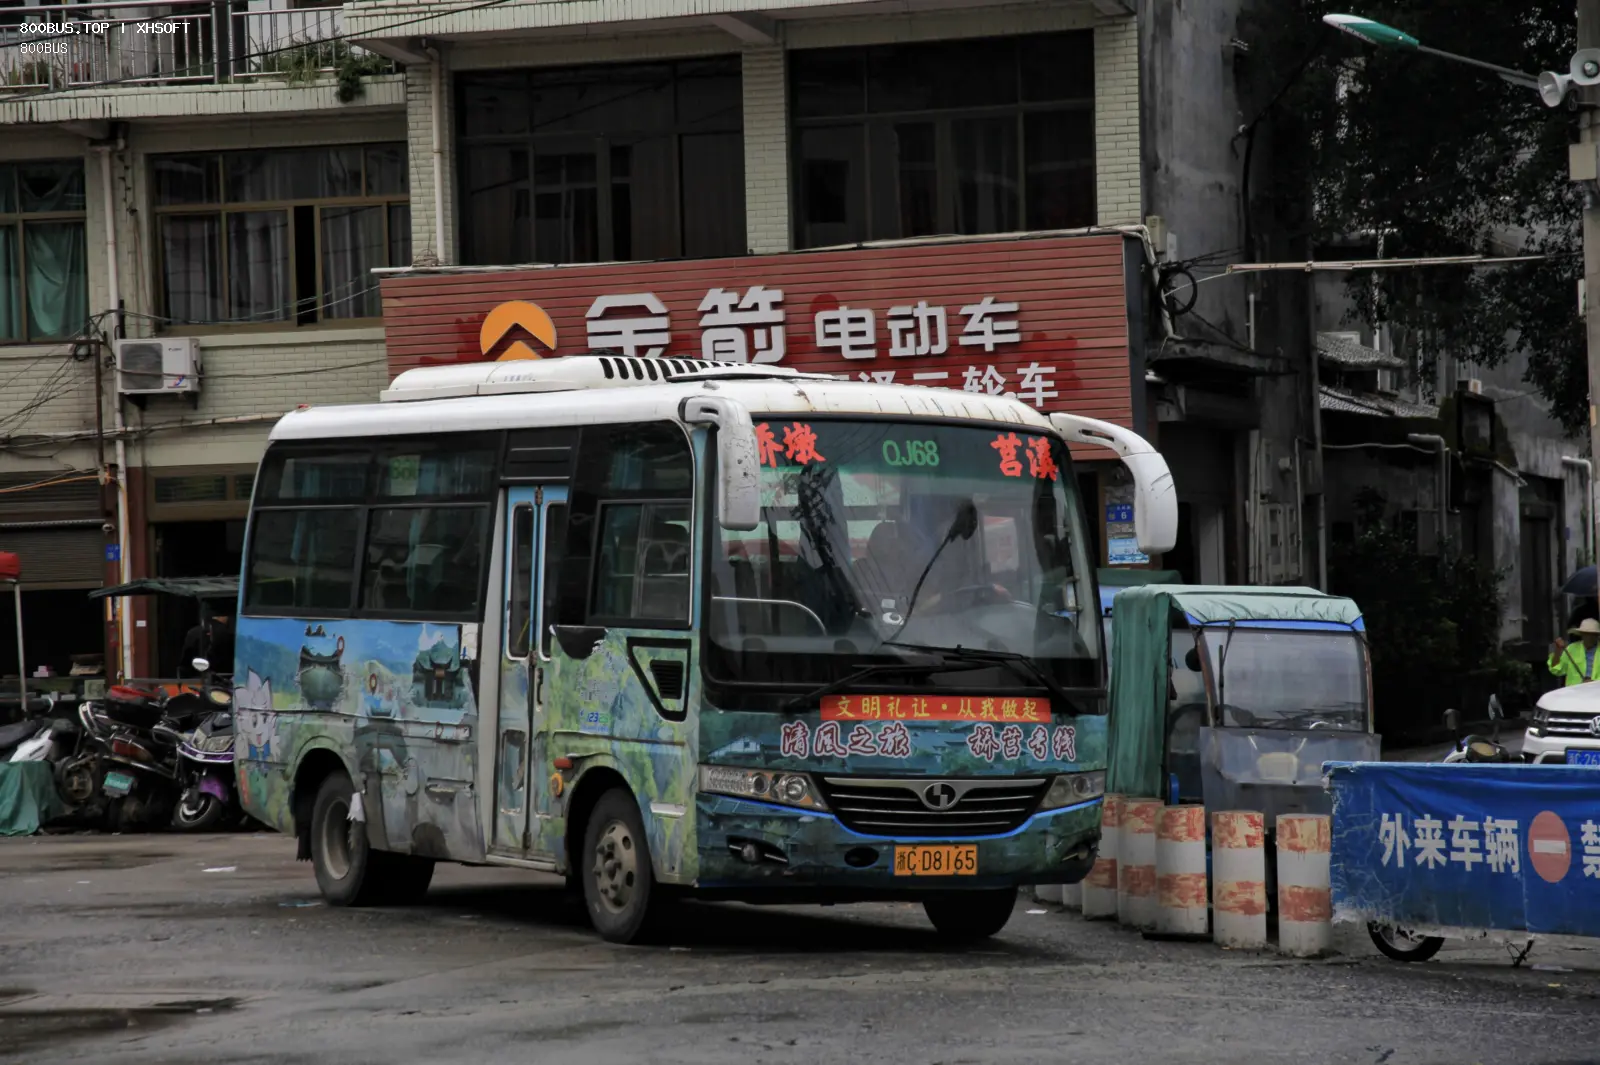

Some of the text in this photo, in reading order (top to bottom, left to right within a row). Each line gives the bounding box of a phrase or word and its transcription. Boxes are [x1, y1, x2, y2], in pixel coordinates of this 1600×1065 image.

[584, 285, 1022, 364] 金箭 电动车
[882, 439, 940, 467] QJ68
[1121, 511, 1128, 520] 6
[1378, 812, 1520, 873] 外来车辆
